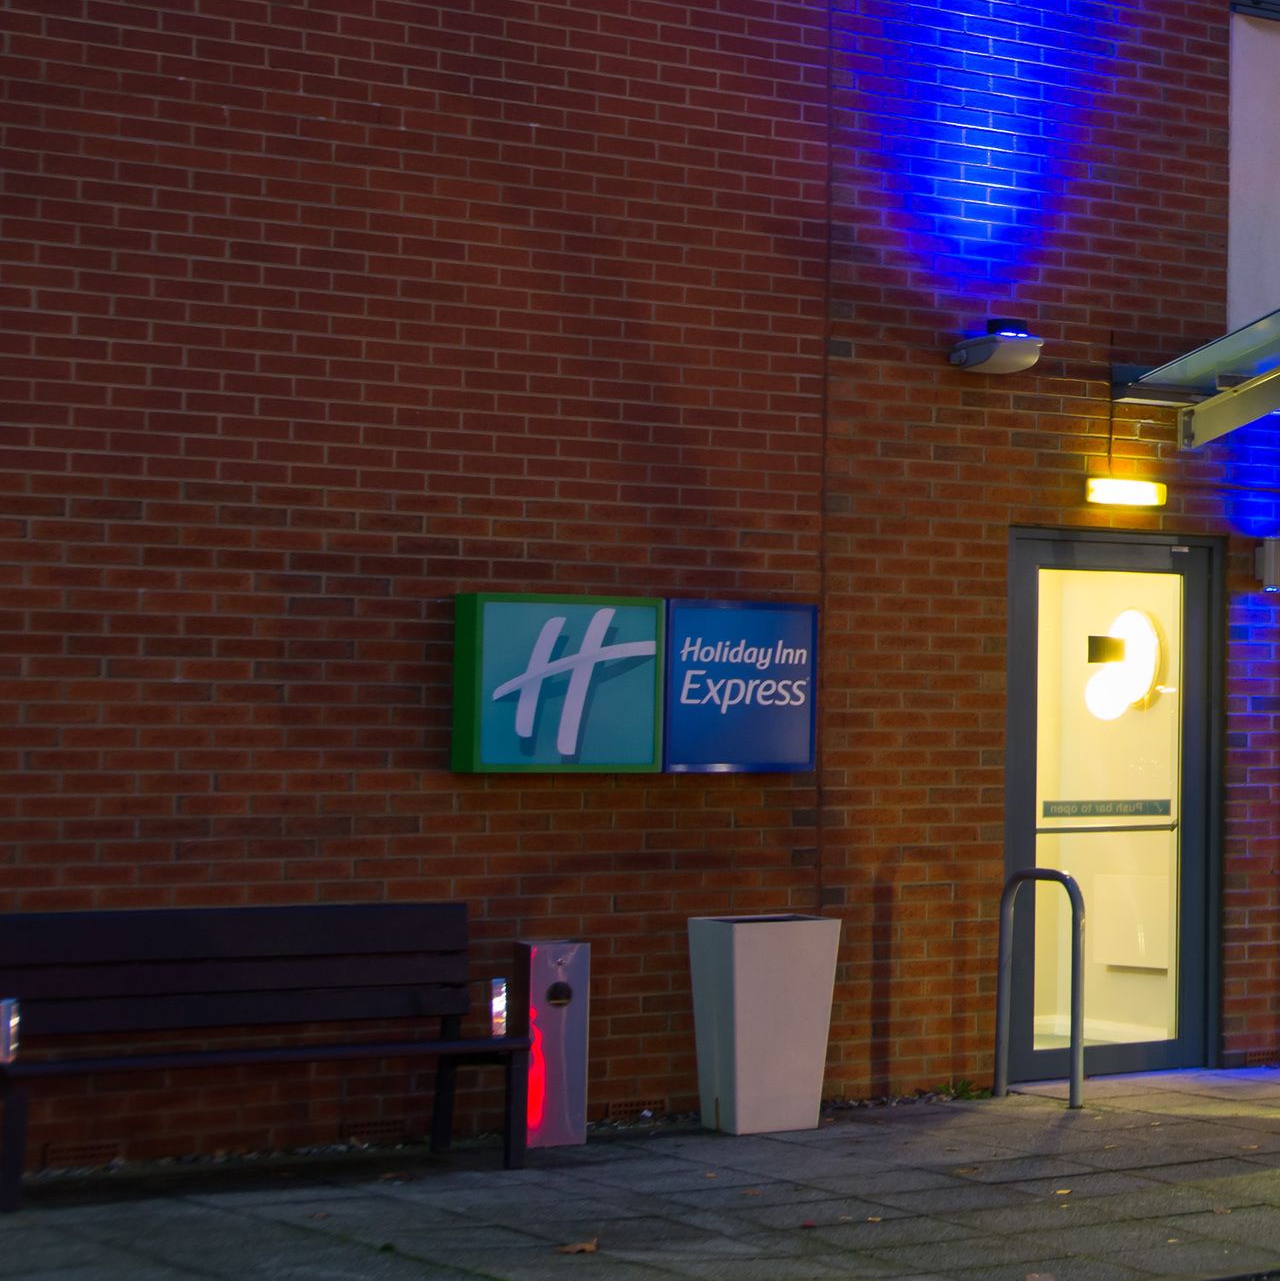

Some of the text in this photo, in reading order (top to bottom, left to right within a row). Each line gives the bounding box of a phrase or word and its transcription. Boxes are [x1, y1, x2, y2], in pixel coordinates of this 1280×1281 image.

[680, 637, 807, 669] Holiday Inn
[680, 670, 807, 714] Express
